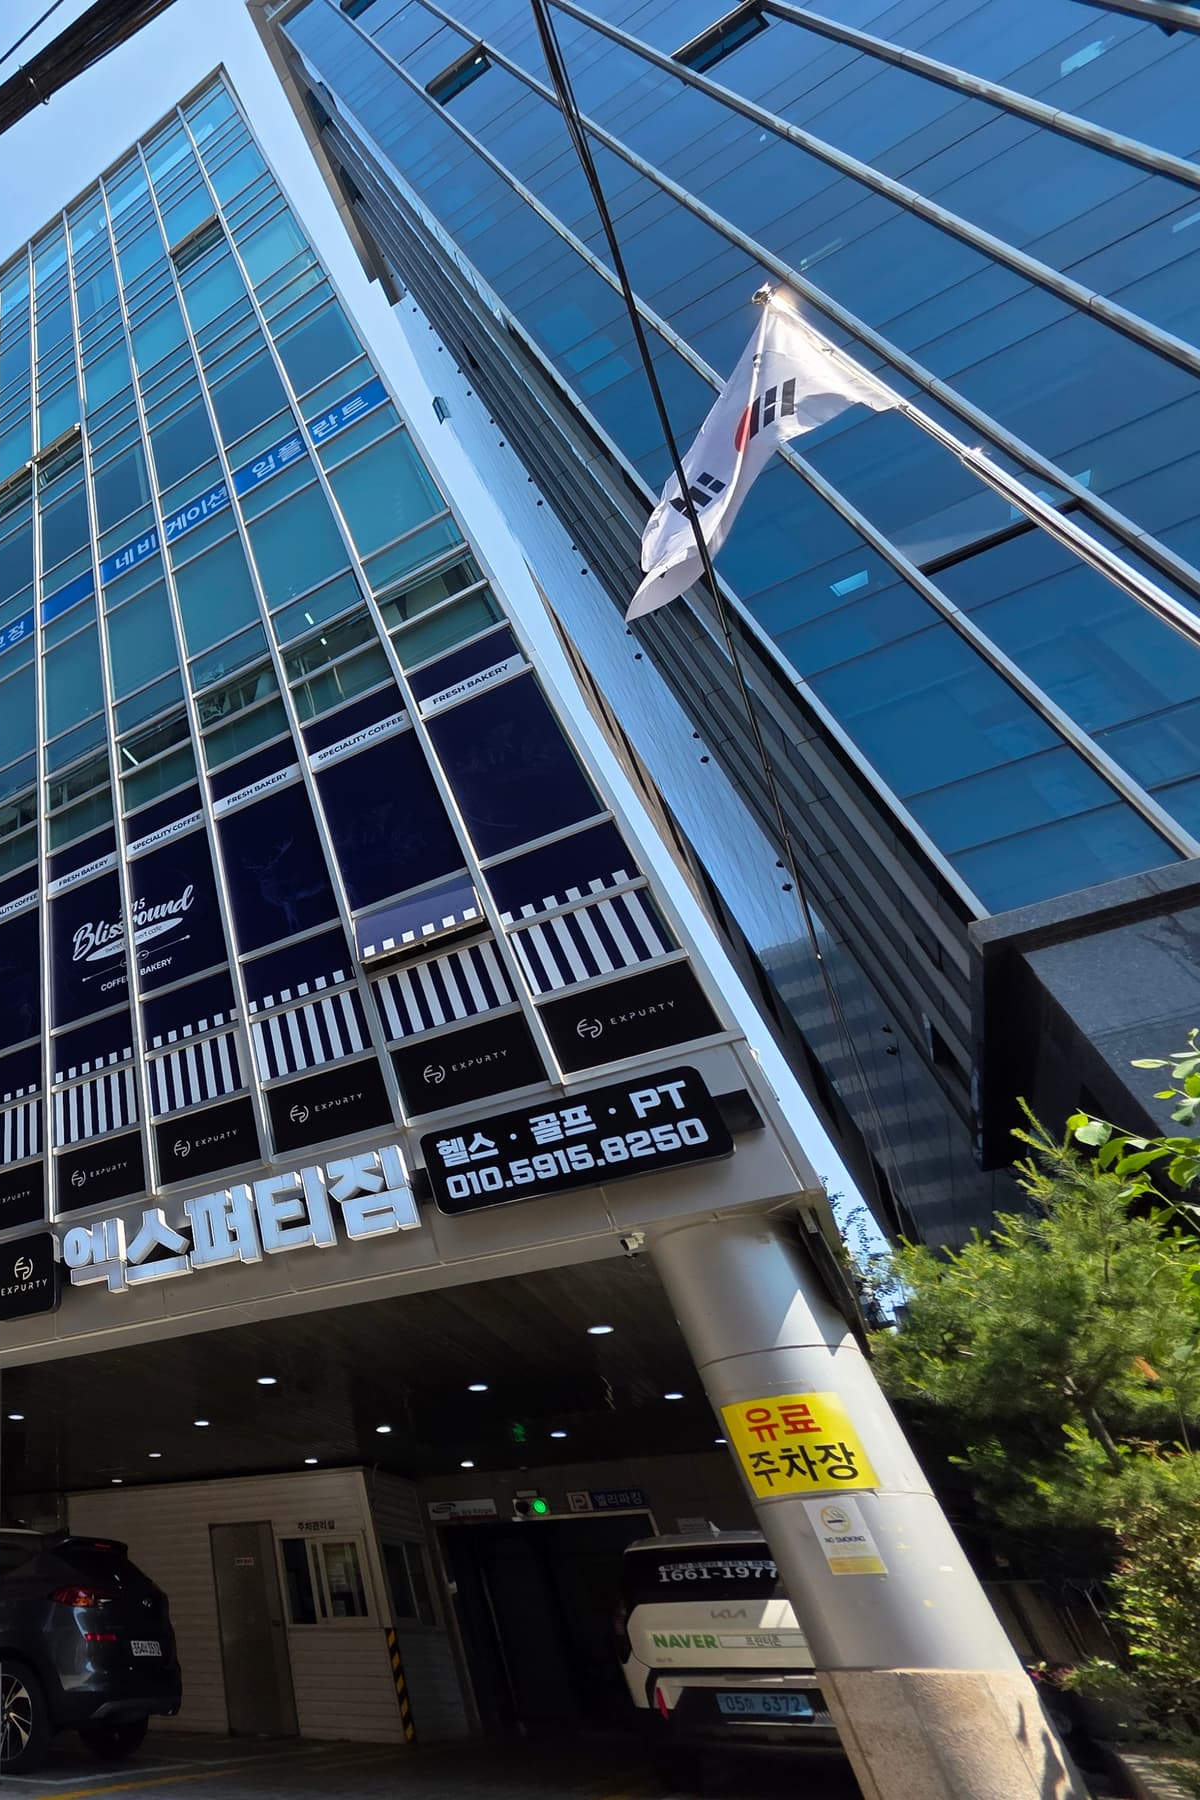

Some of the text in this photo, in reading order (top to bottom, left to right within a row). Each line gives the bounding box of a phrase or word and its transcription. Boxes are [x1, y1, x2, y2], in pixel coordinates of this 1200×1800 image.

[114, 484, 231, 572] 네비게이션
[250, 395, 370, 478] 임플란트
[432, 663, 509, 706] FRESH BAKERY
[317, 715, 405, 762] SPECIALITY COFFEE
[226, 771, 288, 806] FRESH BAKERY
[132, 813, 201, 851] SPECIALITY COFFEE
[58, 858, 109, 887] FRESH BAKERY
[14, 893, 38, 908] COFFEE
[100, 956, 173, 992] COFFE BAKERY
[609, 999, 677, 1026] EXPURTY
[451, 1049, 508, 1074] EXPURTY
[314, 1092, 363, 1114] EXPURTY
[194, 1129, 239, 1149] EXPURTY
[435, 1080, 687, 1169] 헬스 골프 PT
[89, 1161, 128, 1179] EXPURTY
[446, 1117, 710, 1200] 010.5915.8250
[62, 1143, 423, 1295] 엑스퍼티짐
[0, 1277, 49, 1298] EXPURTY
[745, 1403, 823, 1443] 유료
[748, 1441, 860, 1488] 주차장
[824, 1535, 867, 1544] NO SMOKING
[658, 1566, 779, 1583] 1661-1977
[652, 1633, 720, 1649] NAVER
[761, 1696, 803, 1713] 6372
